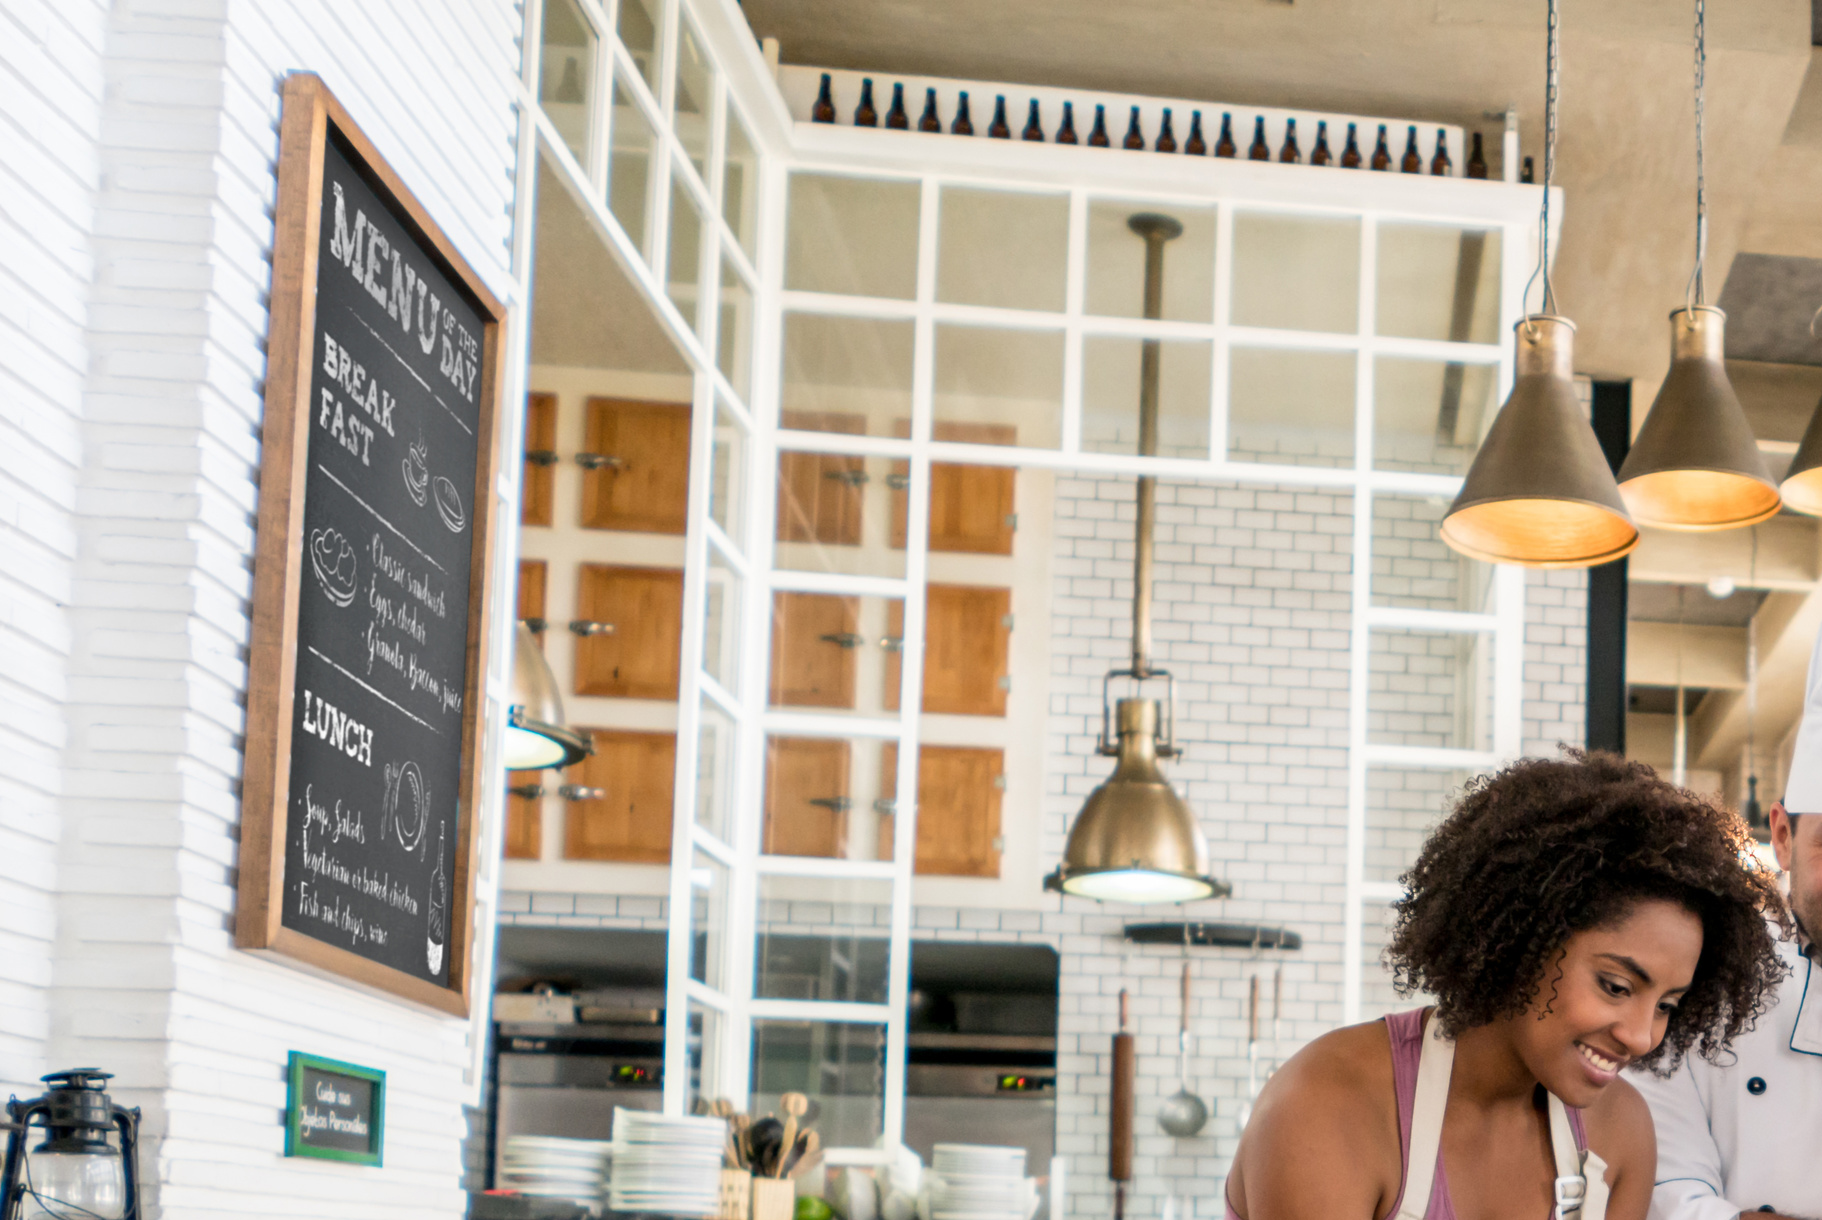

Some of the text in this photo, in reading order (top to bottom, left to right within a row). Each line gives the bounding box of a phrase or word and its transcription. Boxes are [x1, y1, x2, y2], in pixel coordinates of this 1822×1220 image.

[330, 181, 441, 355] MENU
[440, 333, 477, 403] DAY
[443, 308, 478, 364] OF THE
[323, 331, 396, 438] BREAK
[320, 387, 374, 467] FAST
[370, 572, 396, 628] Eggs,
[372, 533, 446, 619] Classic sandwich
[367, 621, 407, 675] Granola,
[442, 678, 462, 715] juice
[302, 689, 373, 767] LUNCH
[332, 799, 365, 845] Salads
[299, 881, 319, 918] Fish
[321, 895, 340, 928] and
[303, 829, 350, 884] Vegetarian
[362, 867, 388, 902] baked
[389, 881, 418, 916] chicken
